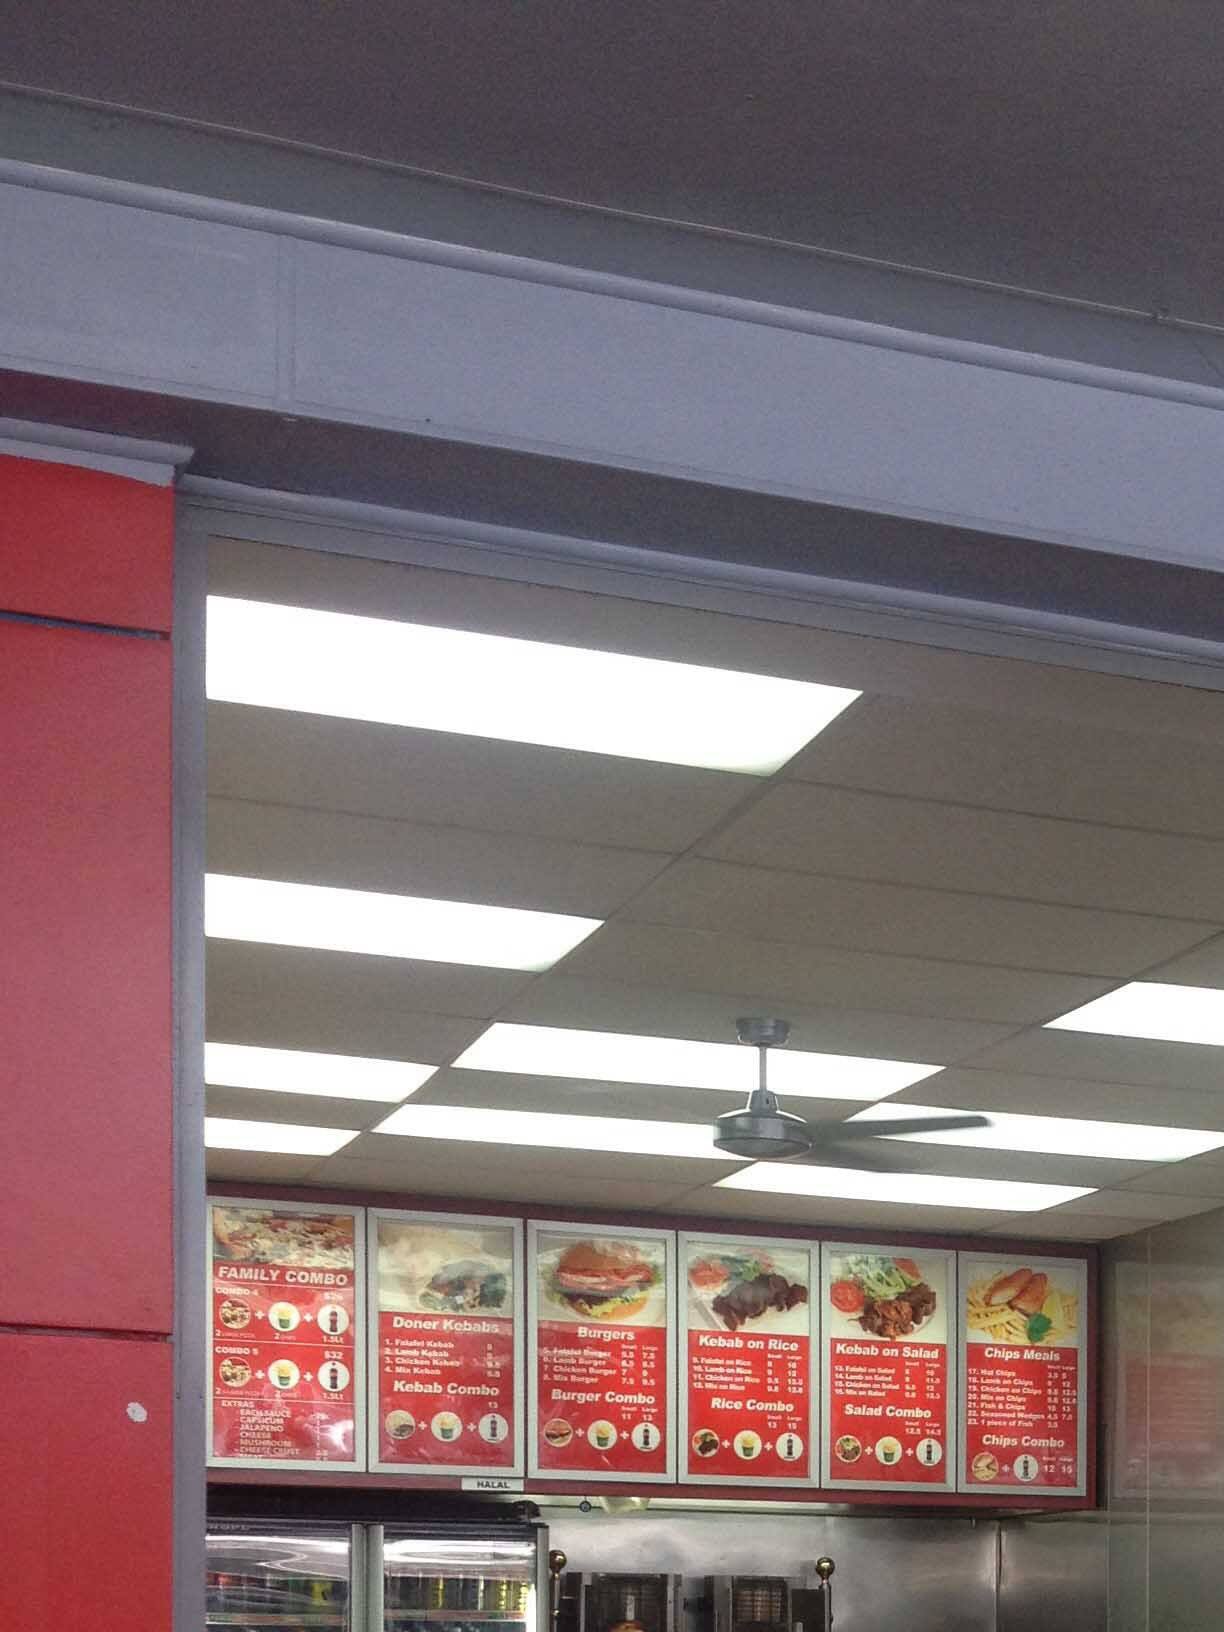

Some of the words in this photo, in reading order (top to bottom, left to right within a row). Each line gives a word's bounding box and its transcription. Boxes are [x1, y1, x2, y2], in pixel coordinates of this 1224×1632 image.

[218, 1266, 280, 1281] FAMILY
[285, 1270, 348, 1286] COMBO
[393, 1316, 439, 1330] Doner
[443, 1319, 499, 1334] Kebabs
[578, 1326, 635, 1342] Burgers
[215, 1346, 250, 1355] COMBO
[427, 1341, 454, 1349] Kebab
[699, 1335, 743, 1348] Kebab
[747, 1340, 764, 1349] on
[768, 1339, 798, 1351] Rice
[395, 1348, 419, 1356] Lamb
[836, 1343, 879, 1356] Kebab
[882, 1348, 898, 1357] on
[902, 1347, 939, 1359] Salad
[984, 1347, 1020, 1361] Chips
[1024, 1349, 1061, 1361] Meals
[395, 1357, 430, 1366] Chicken
[589, 1367, 616, 1376] Burger
[393, 1381, 442, 1394] Kebab
[447, 1383, 499, 1396] Combo
[552, 1389, 601, 1404] Burger
[605, 1391, 655, 1405] Combo
[711, 1398, 742, 1410] Rice
[746, 1399, 794, 1412] Combo
[845, 1404, 882, 1417] Salad
[886, 1405, 932, 1419] Combo
[982, 1434, 1018, 1448] Chips
[1021, 1436, 1065, 1449] Combo
[477, 1481, 510, 1489] HALAL
